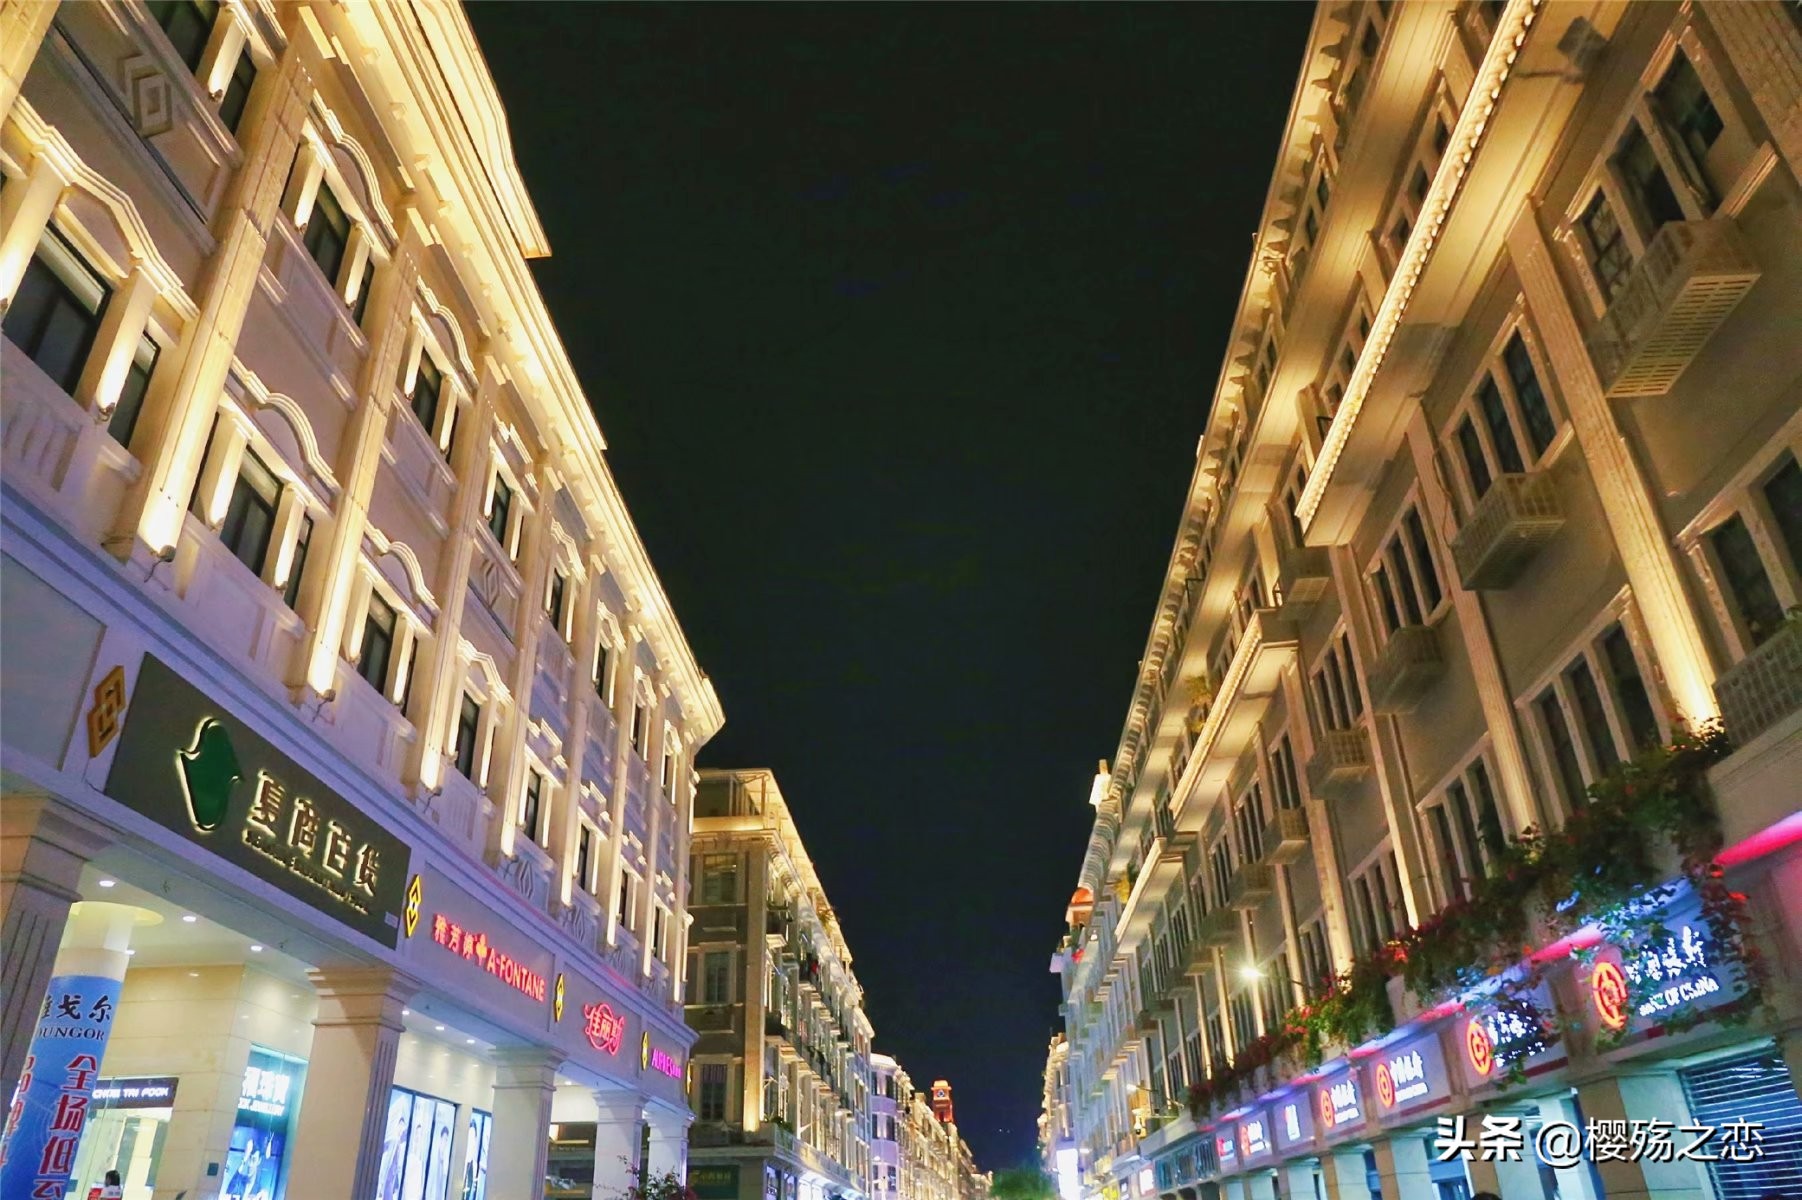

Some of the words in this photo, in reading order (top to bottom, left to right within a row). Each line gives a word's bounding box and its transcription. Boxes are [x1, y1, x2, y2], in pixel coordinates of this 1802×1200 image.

[247, 768, 379, 897] 夏商百货
[486, 947, 545, 1003] A-FONTANE
